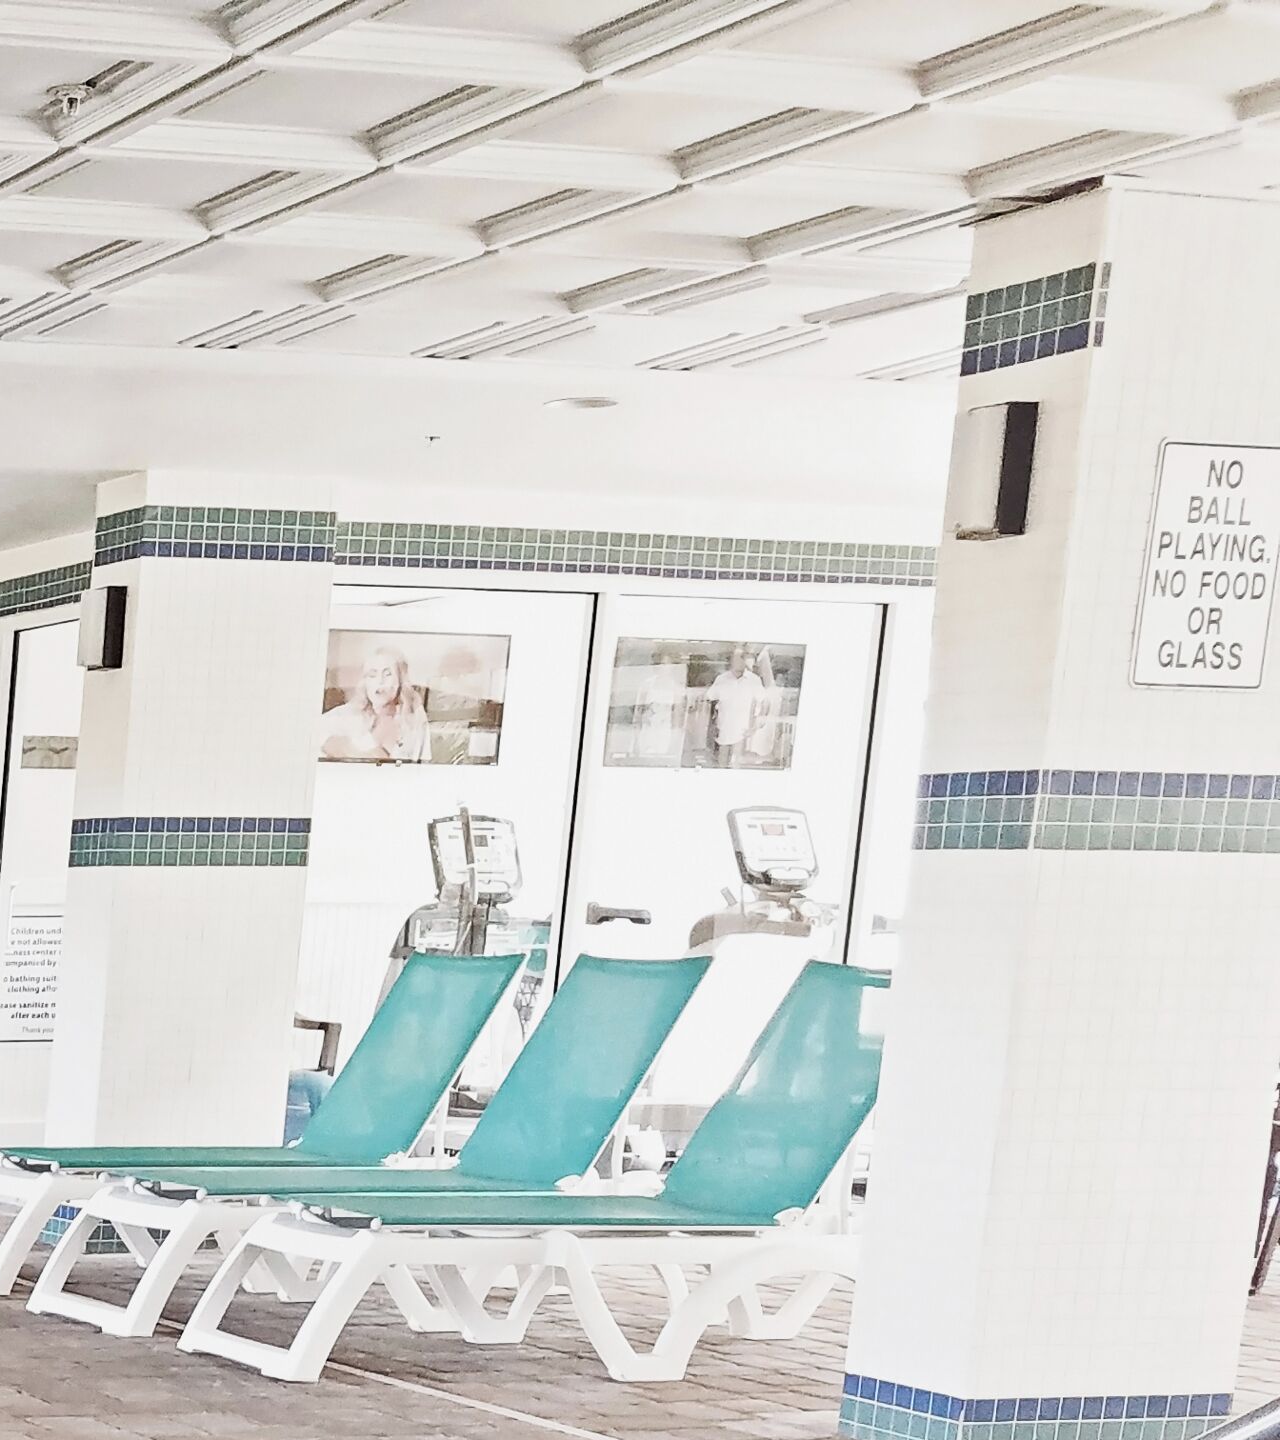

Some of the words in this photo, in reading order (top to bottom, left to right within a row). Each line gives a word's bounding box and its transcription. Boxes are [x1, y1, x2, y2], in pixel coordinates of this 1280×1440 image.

[1207, 460, 1243, 488] NO
[1187, 496, 1251, 526] BALL
[1152, 569, 1186, 598] NO
[1198, 571, 1266, 600] FOOD
[1188, 606, 1223, 634] OR
[1158, 640, 1243, 670] GLASS
